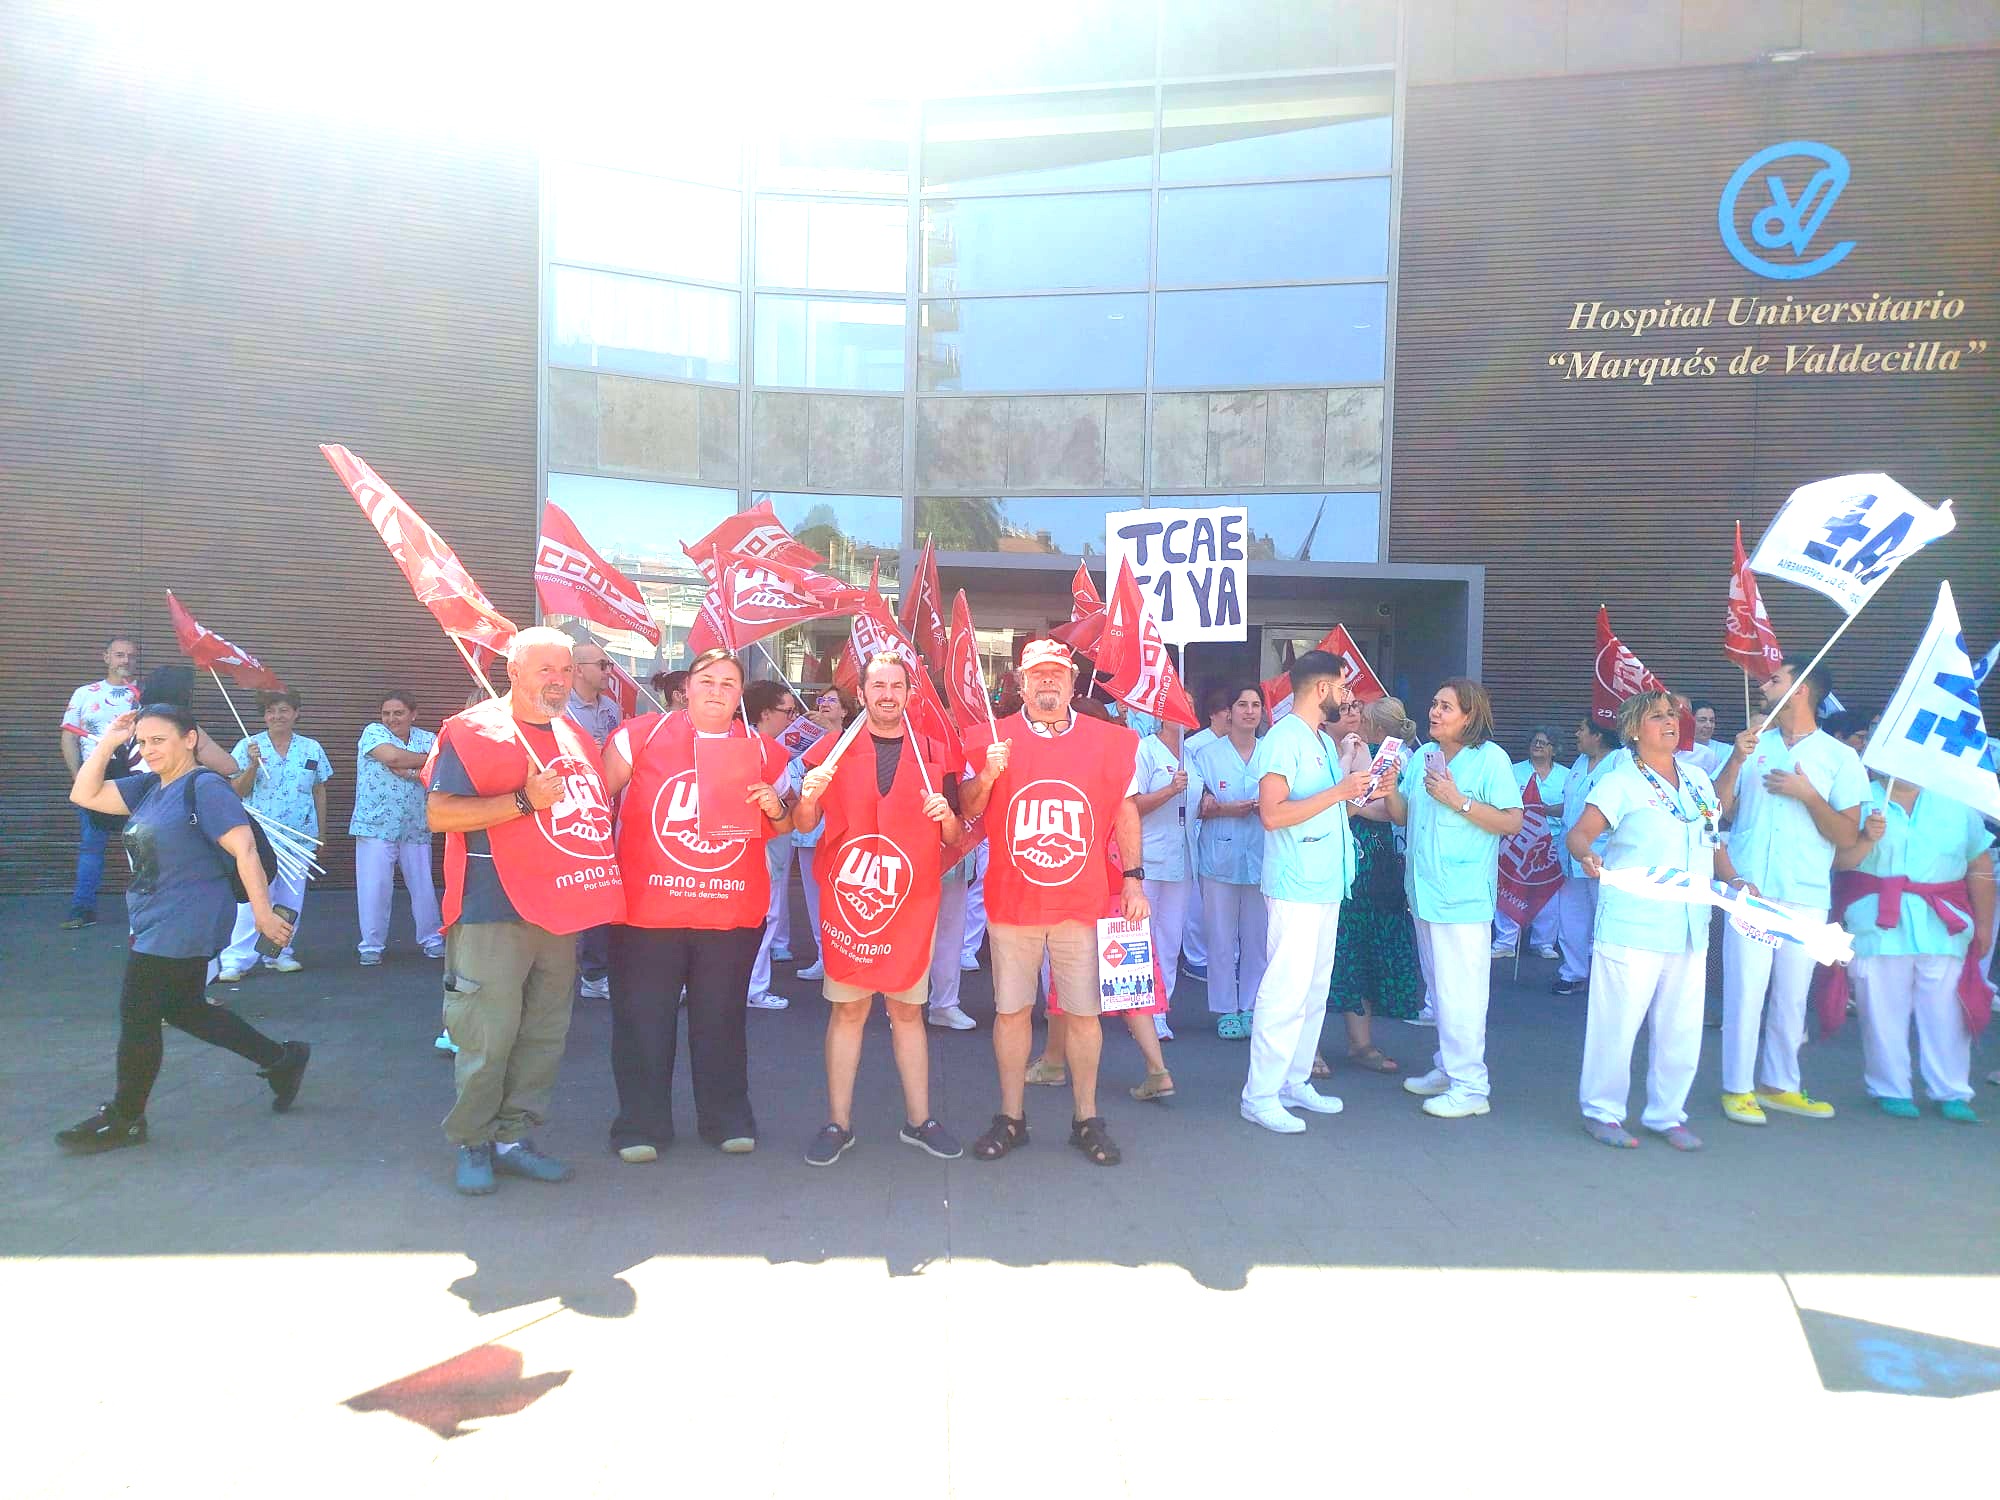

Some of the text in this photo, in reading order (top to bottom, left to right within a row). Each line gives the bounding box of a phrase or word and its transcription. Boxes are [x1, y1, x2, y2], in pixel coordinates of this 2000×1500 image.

[1567, 290, 1966, 337] Hospital Universitario
[1547, 339, 1988, 386] “Marqués de Valdecilla”
[1117, 515, 1244, 566] TCAE
[1187, 567, 1241, 628] YA
[620, 613, 658, 639] Cantabria
[1013, 799, 1085, 840] UGT
[556, 865, 605, 889] mano
[608, 868, 614, 876] a
[584, 882, 598, 891] Por
[598, 879, 610, 888] tus
[649, 873, 745, 891] mano a mano
[838, 847, 901, 896] UGT
[669, 889, 683, 898] Por
[684, 890, 697, 898] tus
[822, 919, 892, 956] mano a mano
[1107, 920, 1143, 935] ¡HUELGA!
